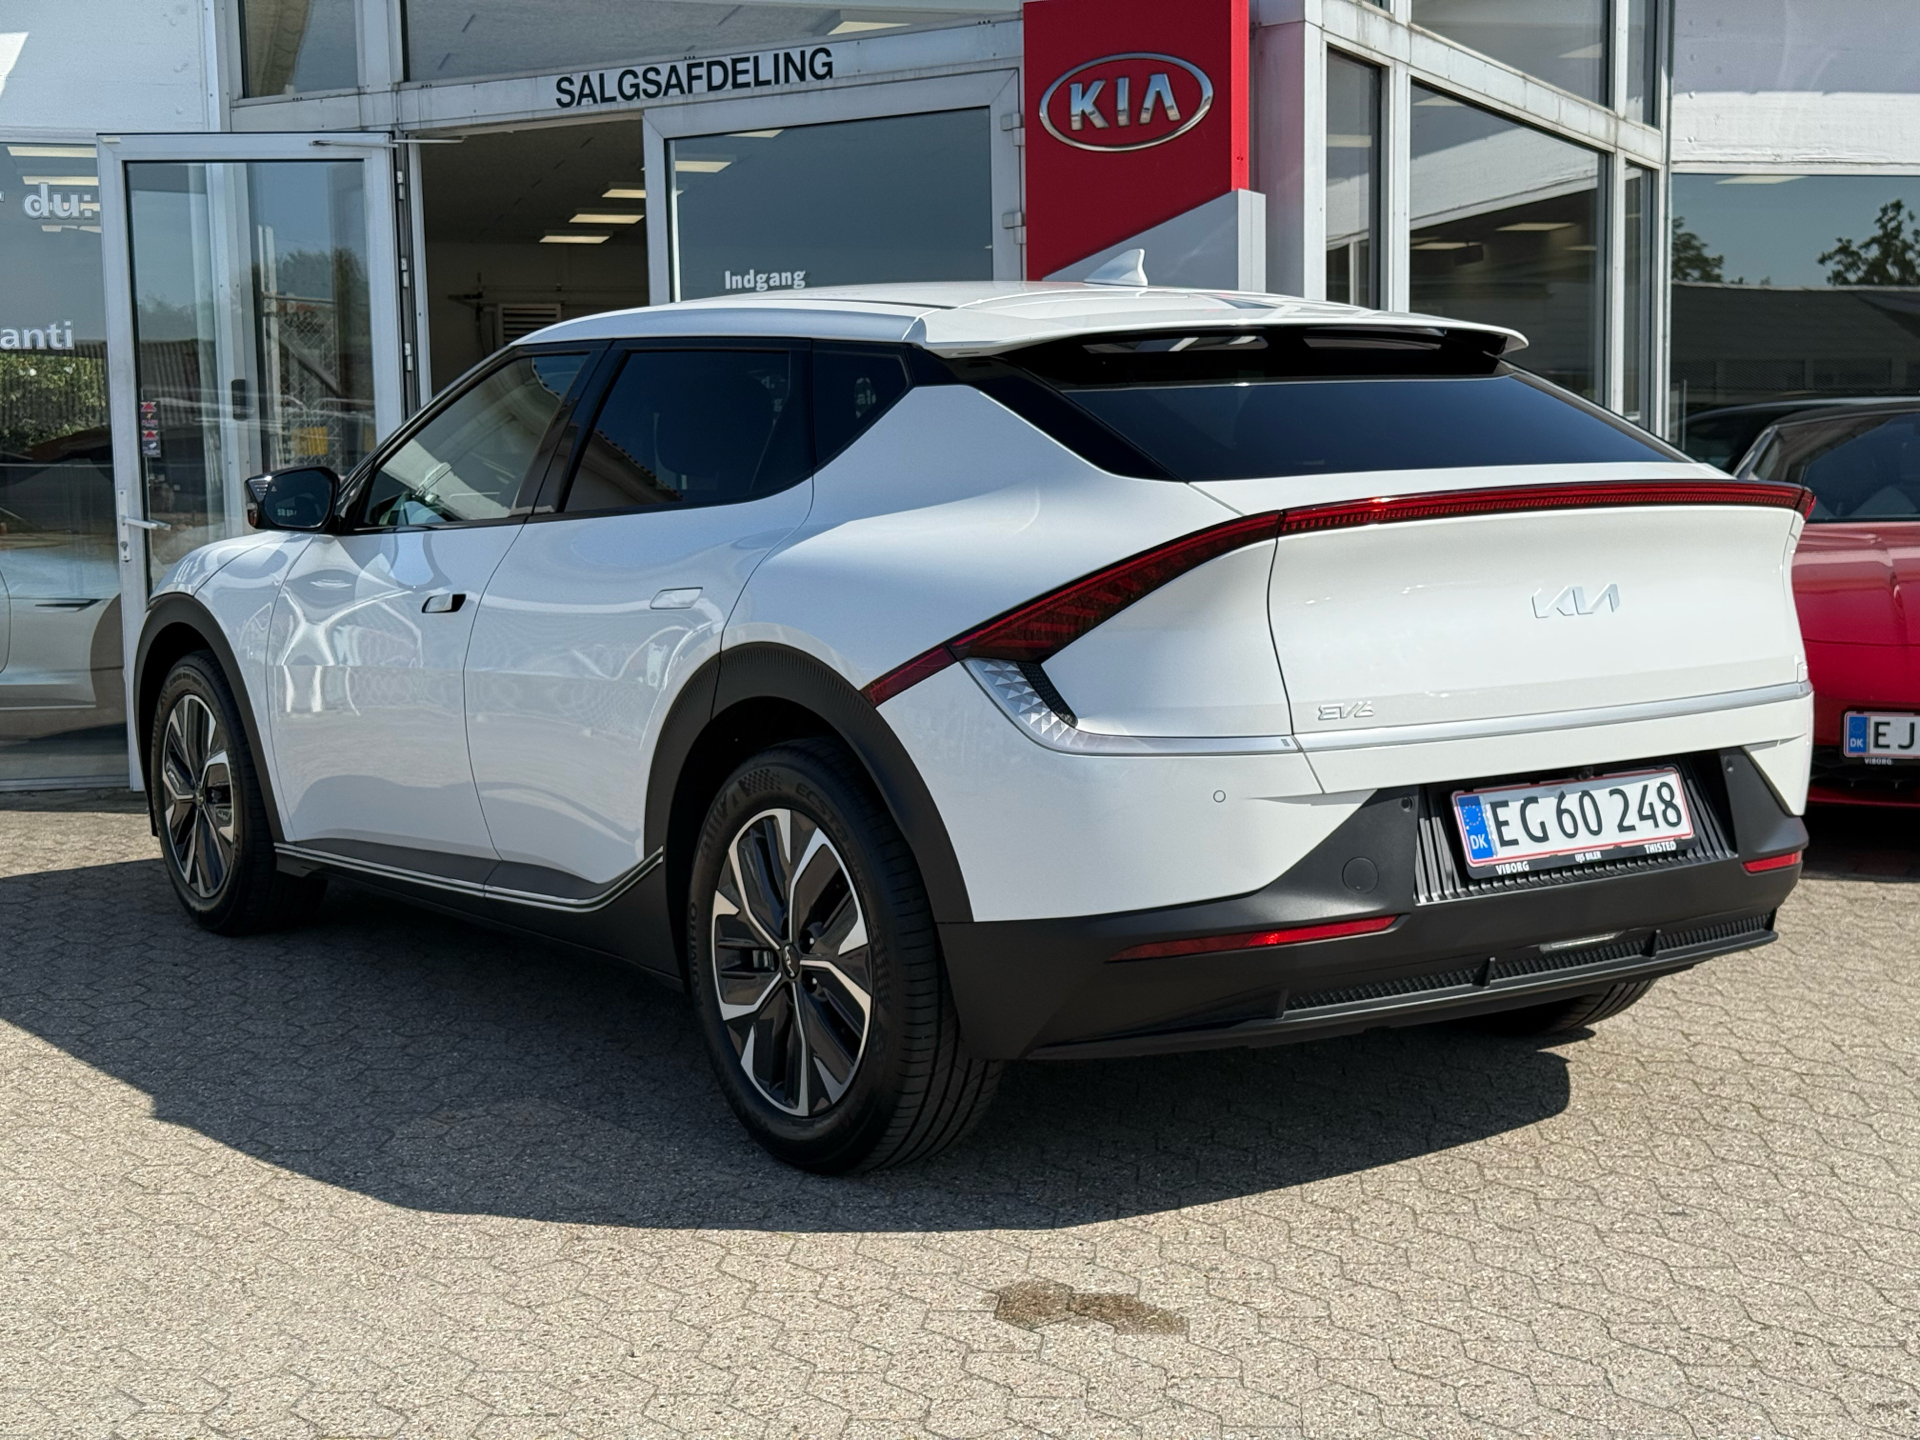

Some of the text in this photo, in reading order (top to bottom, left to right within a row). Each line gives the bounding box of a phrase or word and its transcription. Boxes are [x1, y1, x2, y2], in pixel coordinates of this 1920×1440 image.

[556, 47, 834, 108] SALGSAFDELING
[1070, 73, 1181, 131] KIA
[24, 182, 93, 218] du:
[725, 269, 806, 291] Indgang
[1318, 701, 1375, 721] EV6
[1849, 738, 1864, 748] DK
[1873, 721, 1915, 750] EJ
[1864, 757, 1892, 765] VIBORG
[1489, 781, 1682, 847] EG 60 248
[1470, 833, 1488, 850] DK
[1495, 861, 1530, 875] VIBORG
[1643, 840, 1677, 854] THISTED
